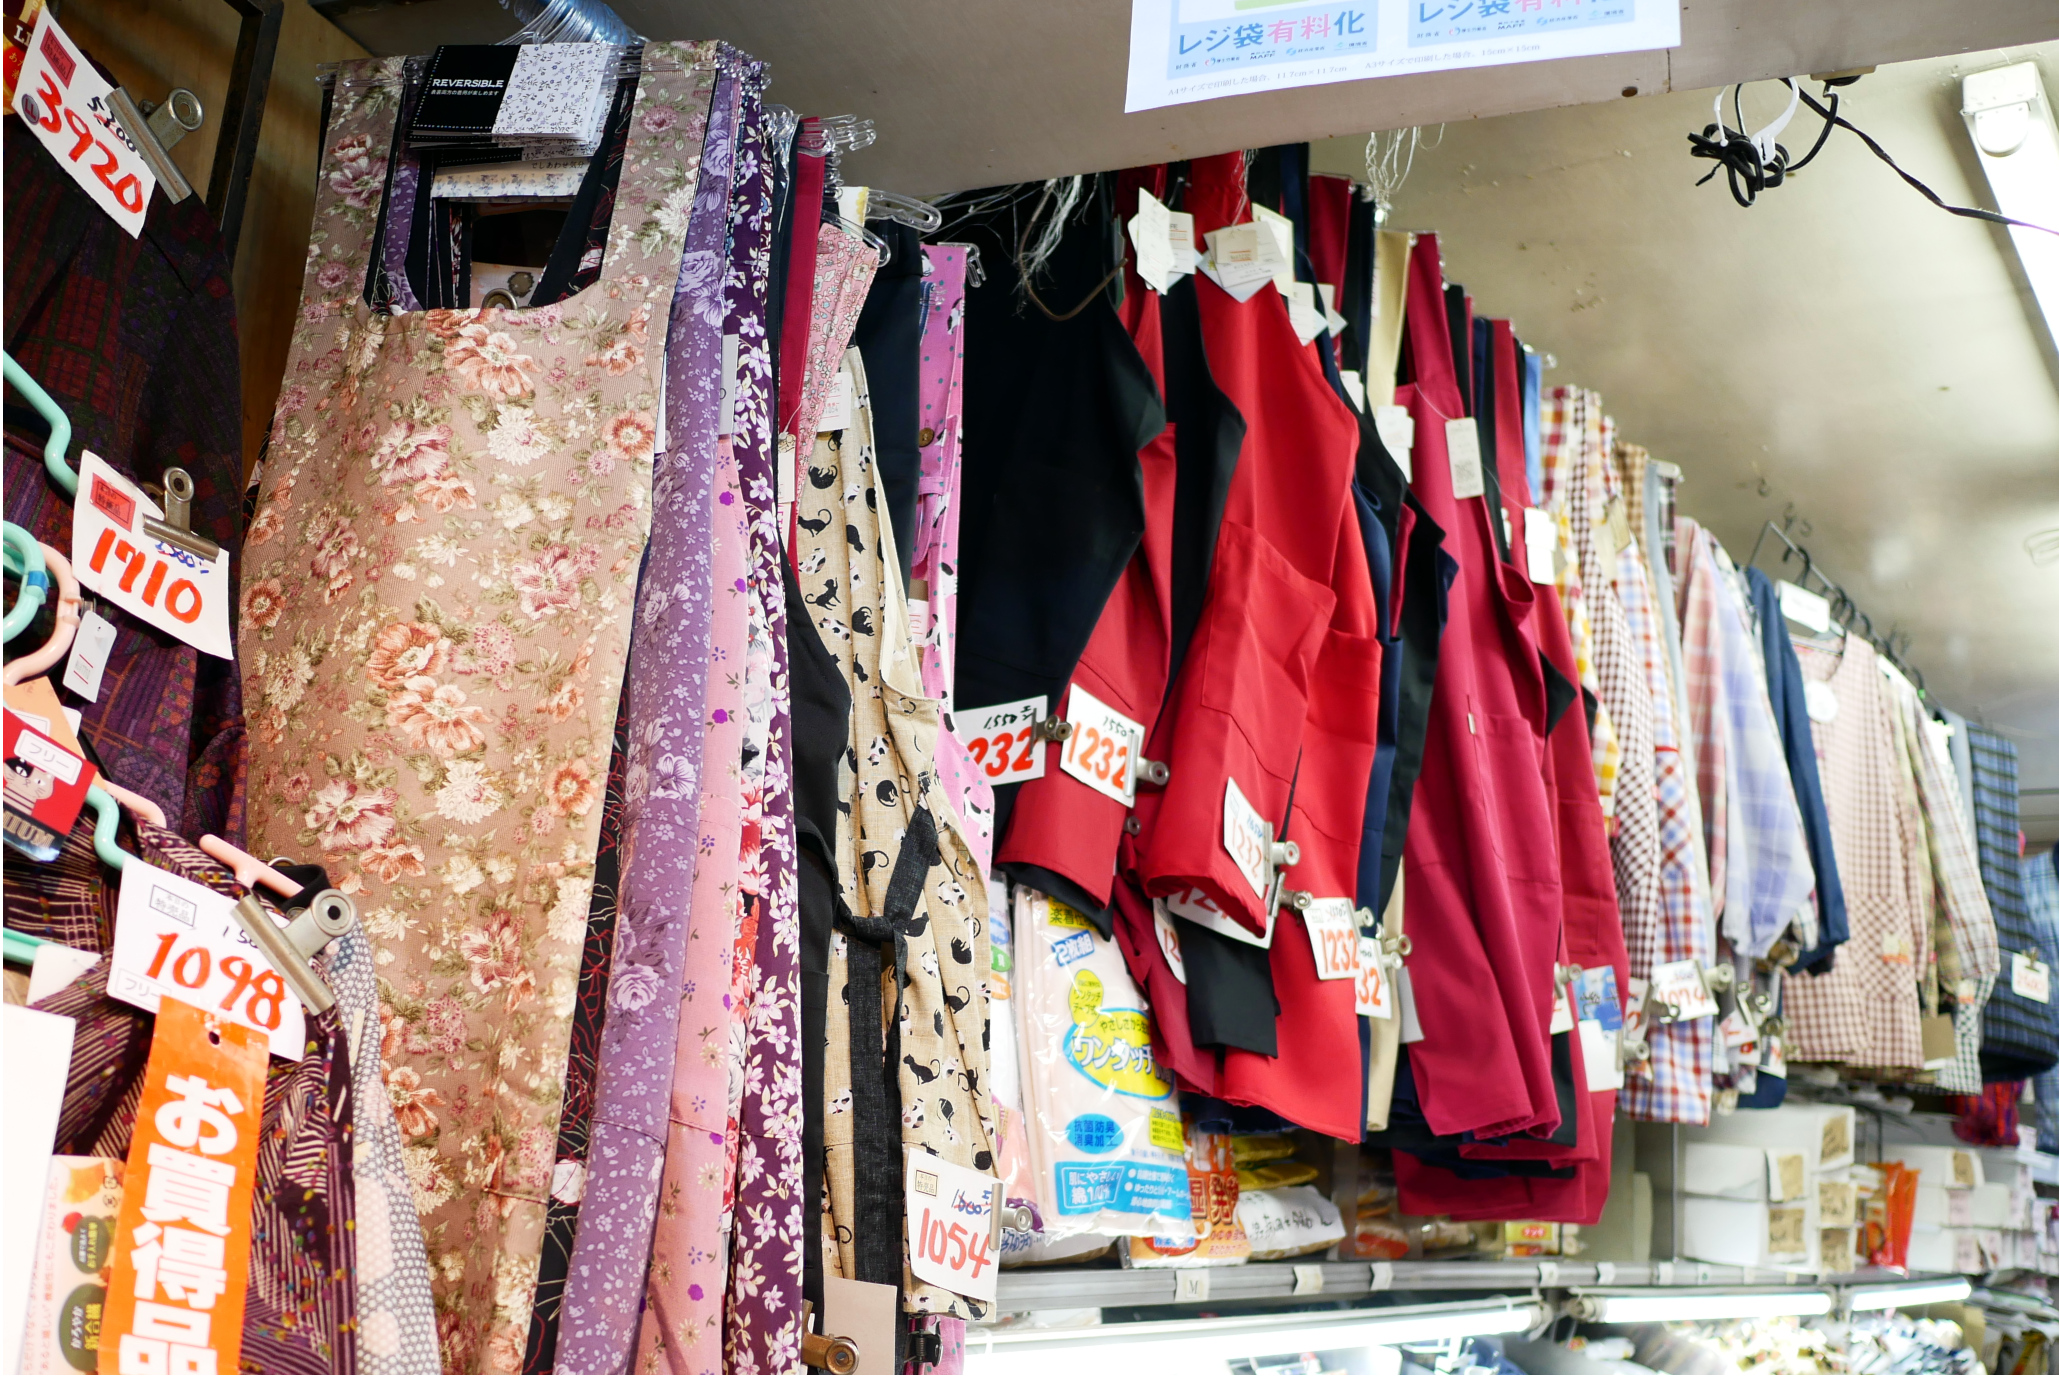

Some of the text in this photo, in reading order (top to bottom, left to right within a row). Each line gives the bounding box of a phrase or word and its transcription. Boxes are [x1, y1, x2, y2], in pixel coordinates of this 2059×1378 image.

[1179, 10, 1365, 55] レジ袋有料化
[1418, 0, 1598, 23] レジ袋
[432, 79, 504, 88] REVERSIBLE
[37, 70, 144, 214] 3920
[89, 527, 203, 624] 1710
[28, 742, 70, 769] フリー
[1068, 721, 1127, 790] 1232
[1232, 818, 1263, 879] 1232
[1056, 933, 1092, 962] 2枚組
[1319, 929, 1360, 974] 1232
[146, 932, 287, 1032] 1098
[1074, 1120, 1115, 1134] 抗菌防臭
[1074, 1133, 1119, 1147] 消臭加工
[918, 1208, 991, 1279] 1054
